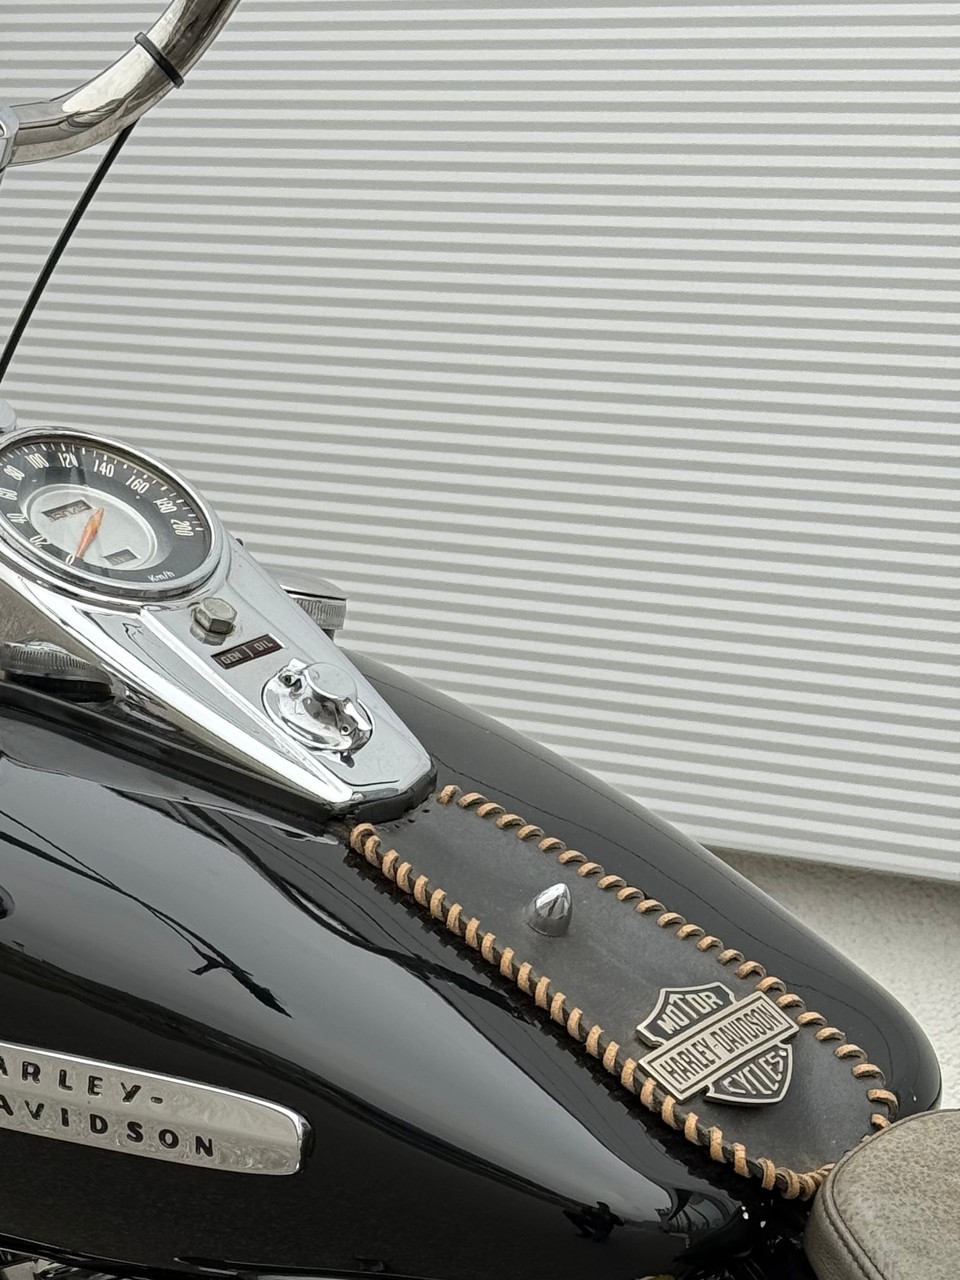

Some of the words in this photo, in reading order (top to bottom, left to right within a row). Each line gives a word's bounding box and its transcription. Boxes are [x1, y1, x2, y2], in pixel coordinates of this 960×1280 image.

[24, 453, 49, 469] 100
[58, 452, 78, 468] 120
[93, 459, 114, 478] 140
[3, 464, 25, 481] 80
[125, 475, 150, 494] 160
[153, 497, 178, 514] 180
[6, 512, 28, 524] 40
[171, 518, 195, 537] 200
[220, 650, 244, 665] GEN
[254, 638, 275, 652] OIL
[656, 990, 725, 1035] MOTOR
[658, 1003, 784, 1086] HARLEY-DAVIDSON
[722, 1051, 785, 1096] CYCLES
